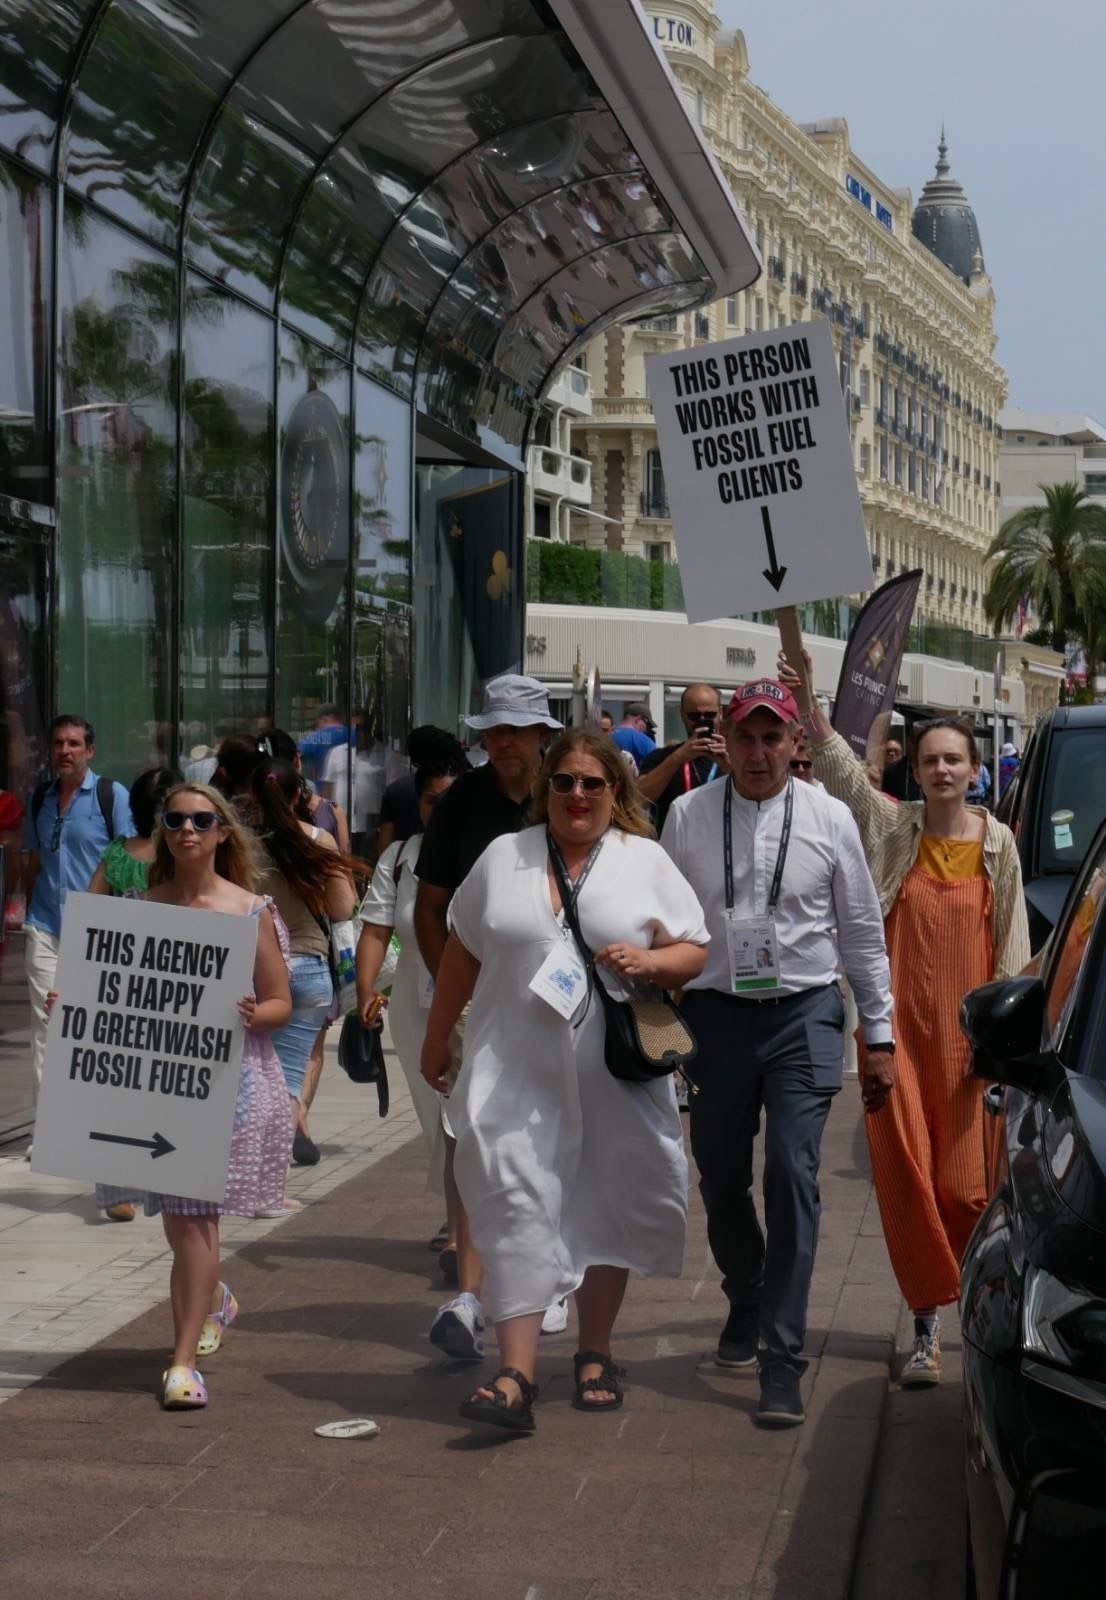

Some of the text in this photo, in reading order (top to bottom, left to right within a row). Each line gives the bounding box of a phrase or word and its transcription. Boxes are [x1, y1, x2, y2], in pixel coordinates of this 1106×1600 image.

[669, 337, 812, 397] THIS PERSON
[675, 375, 820, 435] WORKS WITH
[692, 416, 816, 471] FOSSIL FUEL
[717, 458, 803, 504] CLIENTS
[85, 927, 229, 980] THIS AGENCY
[97, 970, 205, 1017] IS HAPPY
[61, 1004, 232, 1063] TO GREENWASH
[69, 1047, 212, 1101] FOSSIL FUELS
